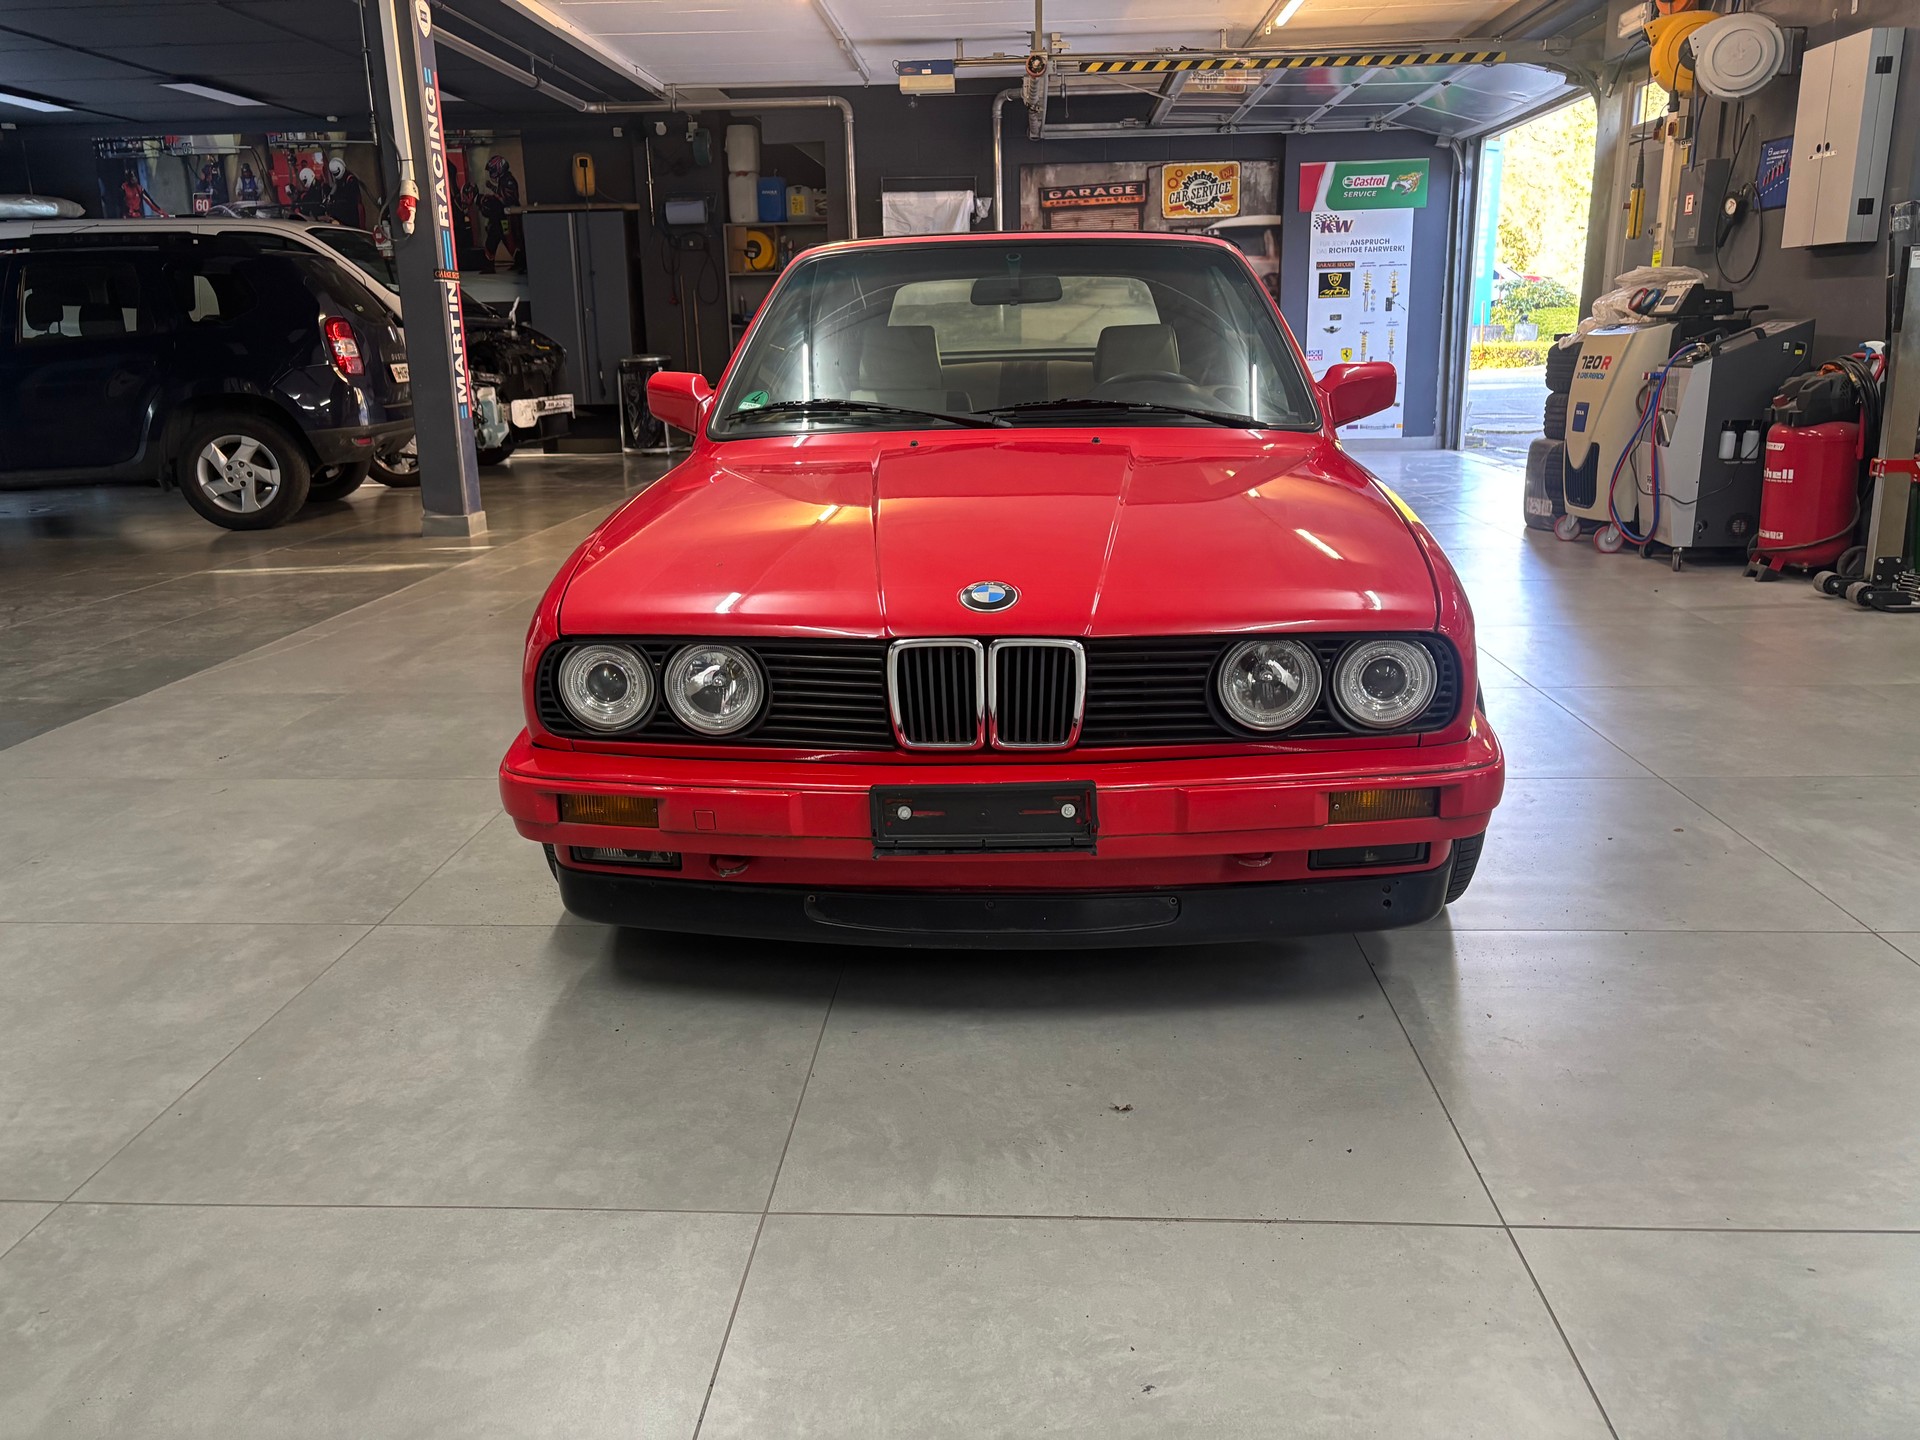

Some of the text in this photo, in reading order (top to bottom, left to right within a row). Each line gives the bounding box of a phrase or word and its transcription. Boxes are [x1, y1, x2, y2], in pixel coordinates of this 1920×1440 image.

[425, 87, 450, 228] RACING
[1353, 175, 1386, 187] Castrol
[1049, 184, 1138, 200] GARAGE
[1169, 181, 1231, 205] CAR SERVICE
[1343, 190, 1377, 198] SERVICE
[195, 199, 209, 212] 60
[1320, 219, 1354, 234] KW
[1350, 238, 1390, 246] ANSPRUCH
[1328, 246, 1363, 254] RICHTIGE
[1364, 245, 1405, 253] FAHRWERK!
[447, 281, 468, 404] MARTIN
[751, 391, 763, 404] 4
[967, 581, 1012, 591] BMW
